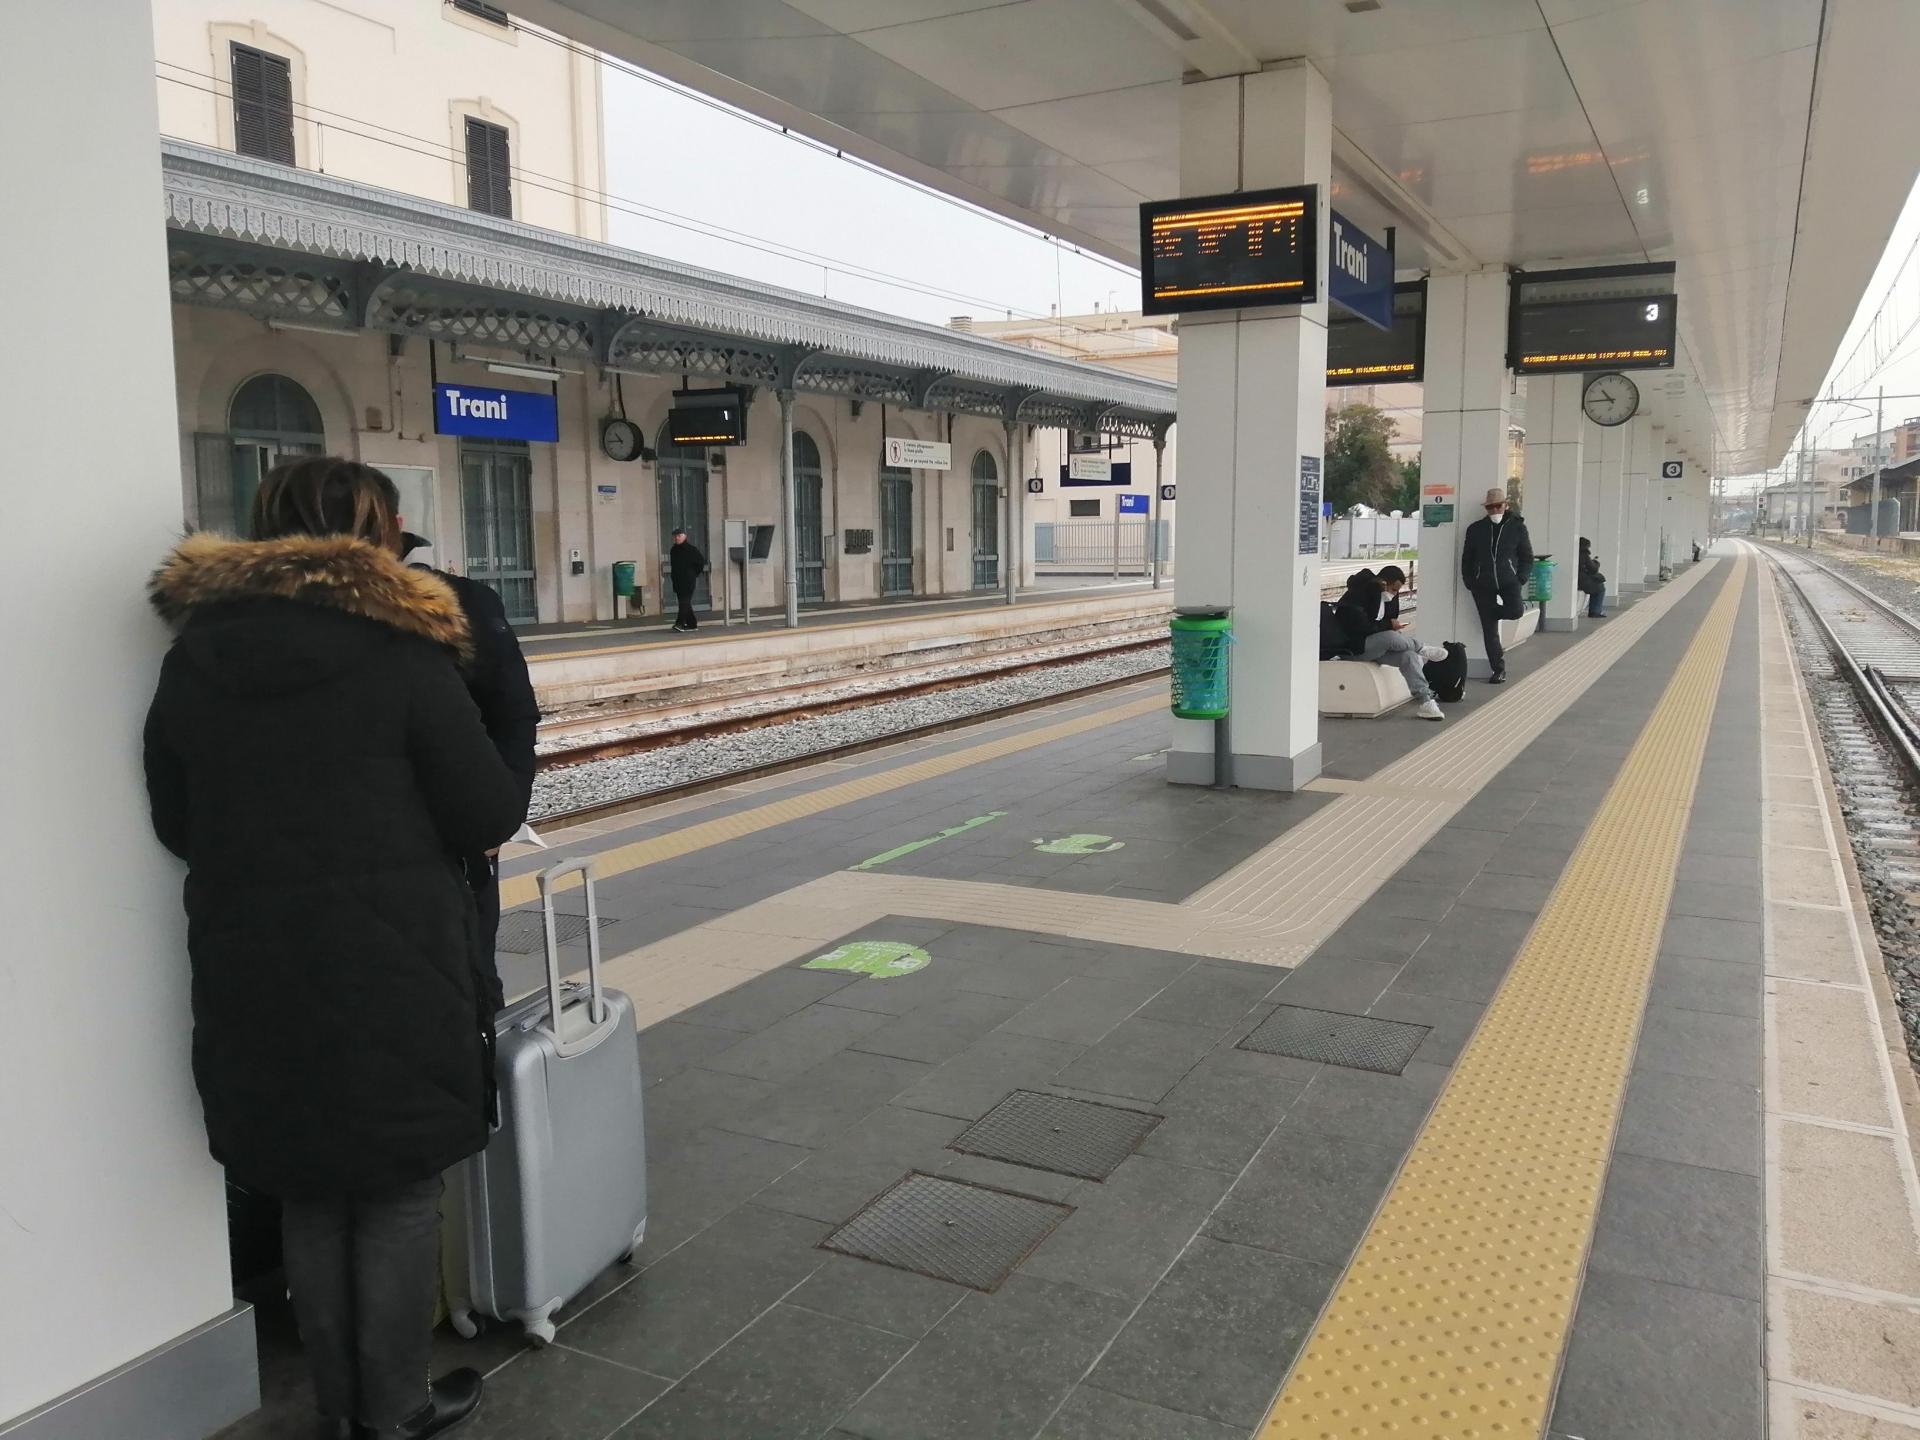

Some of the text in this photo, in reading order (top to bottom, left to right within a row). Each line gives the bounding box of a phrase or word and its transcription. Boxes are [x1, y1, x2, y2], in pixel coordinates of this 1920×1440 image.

[1333, 221, 1368, 284] Trani
[1646, 304, 1659, 321] 3
[446, 389, 508, 420] Trani
[723, 410, 729, 421] 1
